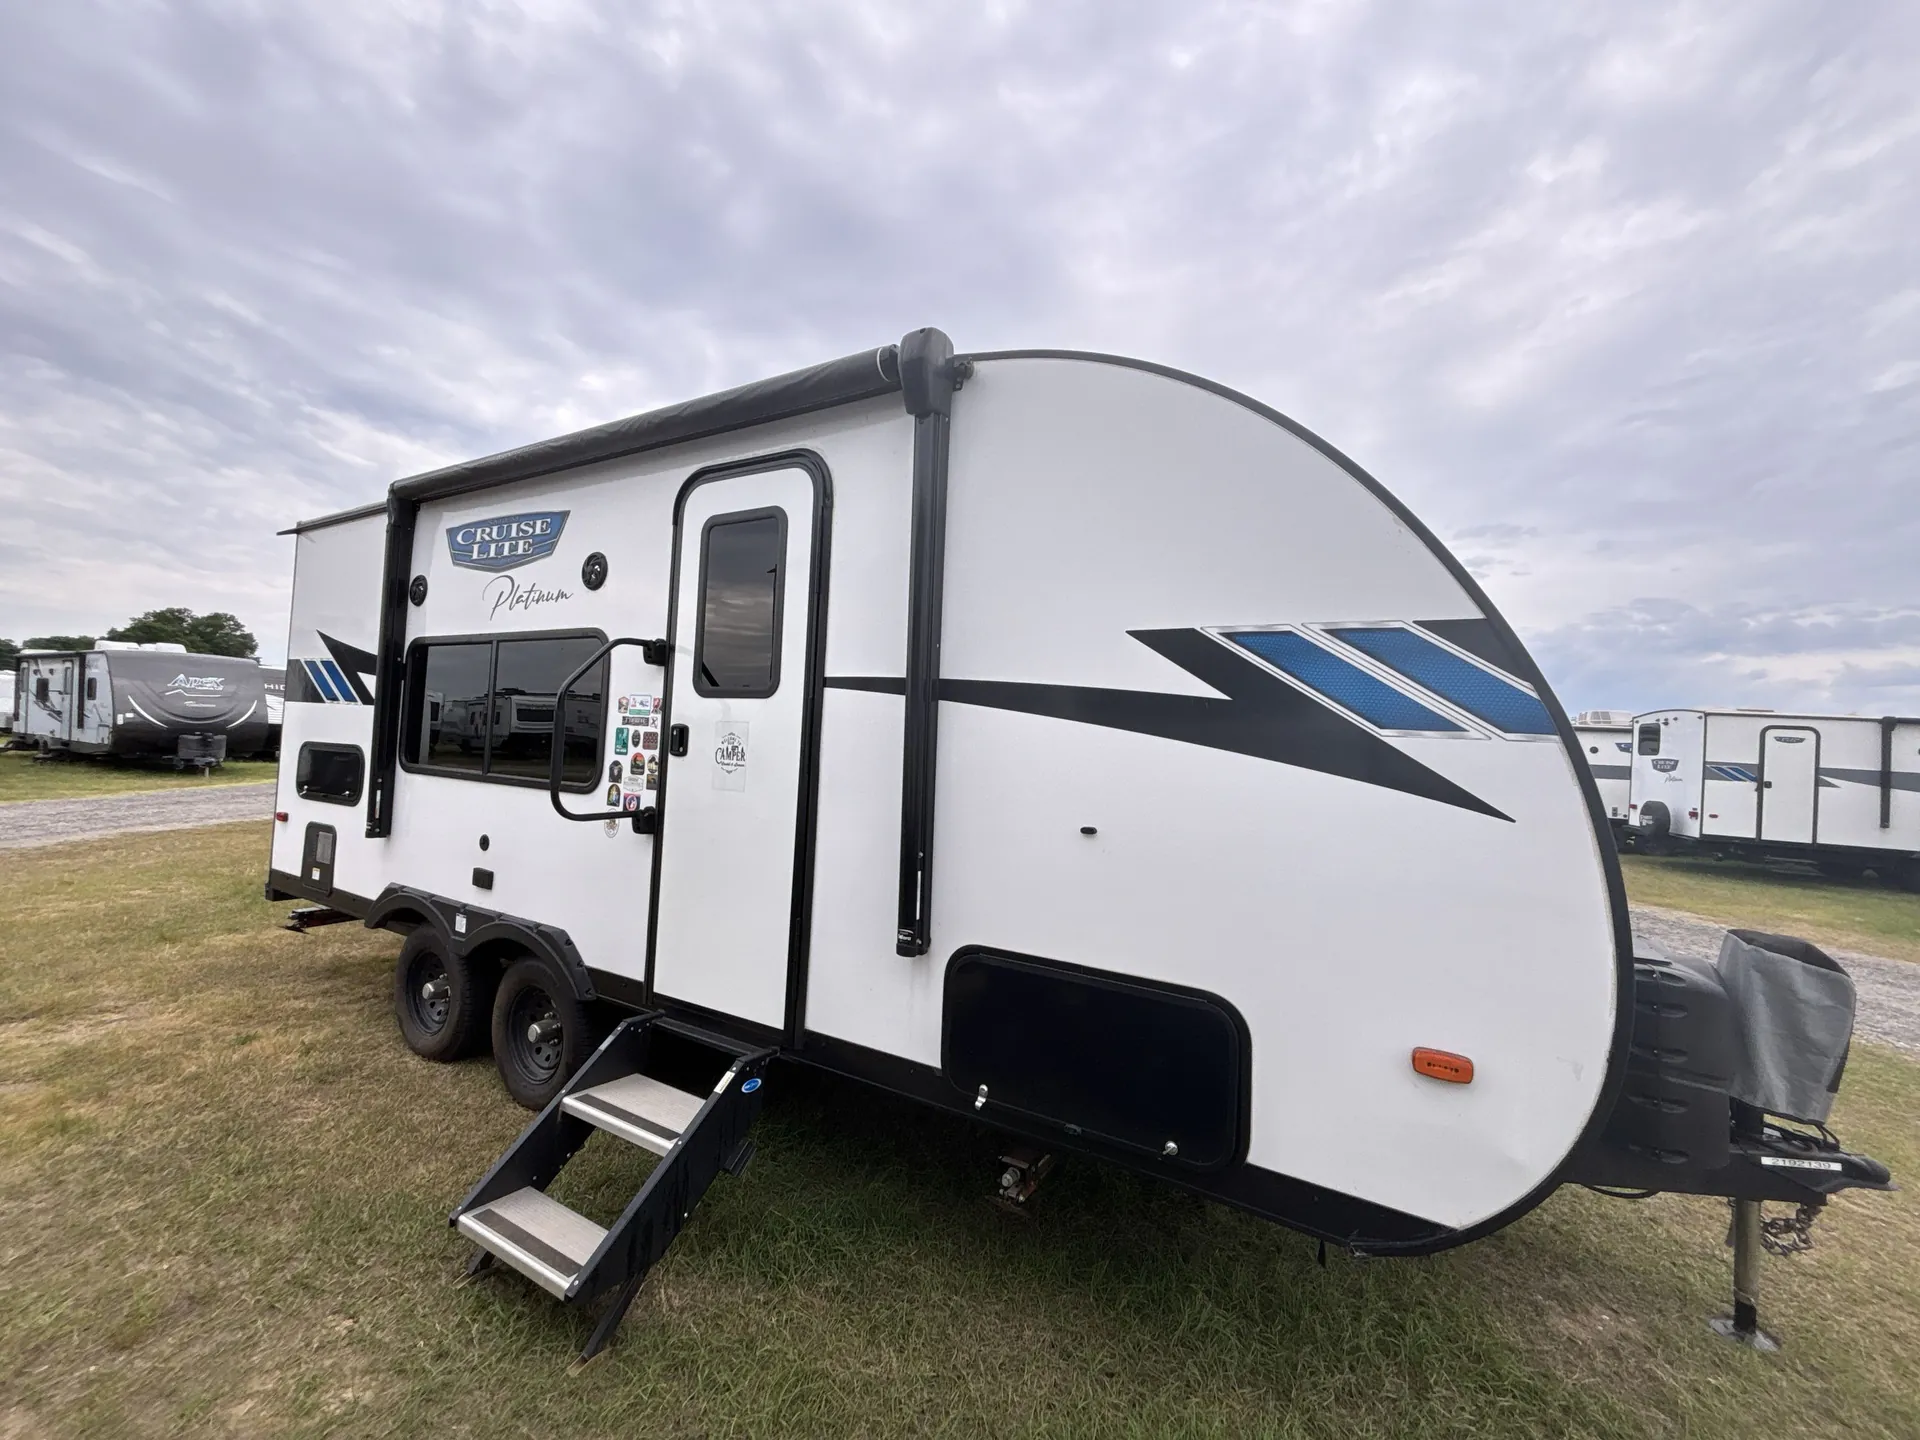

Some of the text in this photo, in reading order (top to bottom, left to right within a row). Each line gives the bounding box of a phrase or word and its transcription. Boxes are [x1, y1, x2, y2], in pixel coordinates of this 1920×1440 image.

[456, 518, 552, 545] CRUISE
[471, 539, 533, 560] LITE
[482, 574, 574, 621] Platinum
[715, 746, 745, 765] CAMPER
